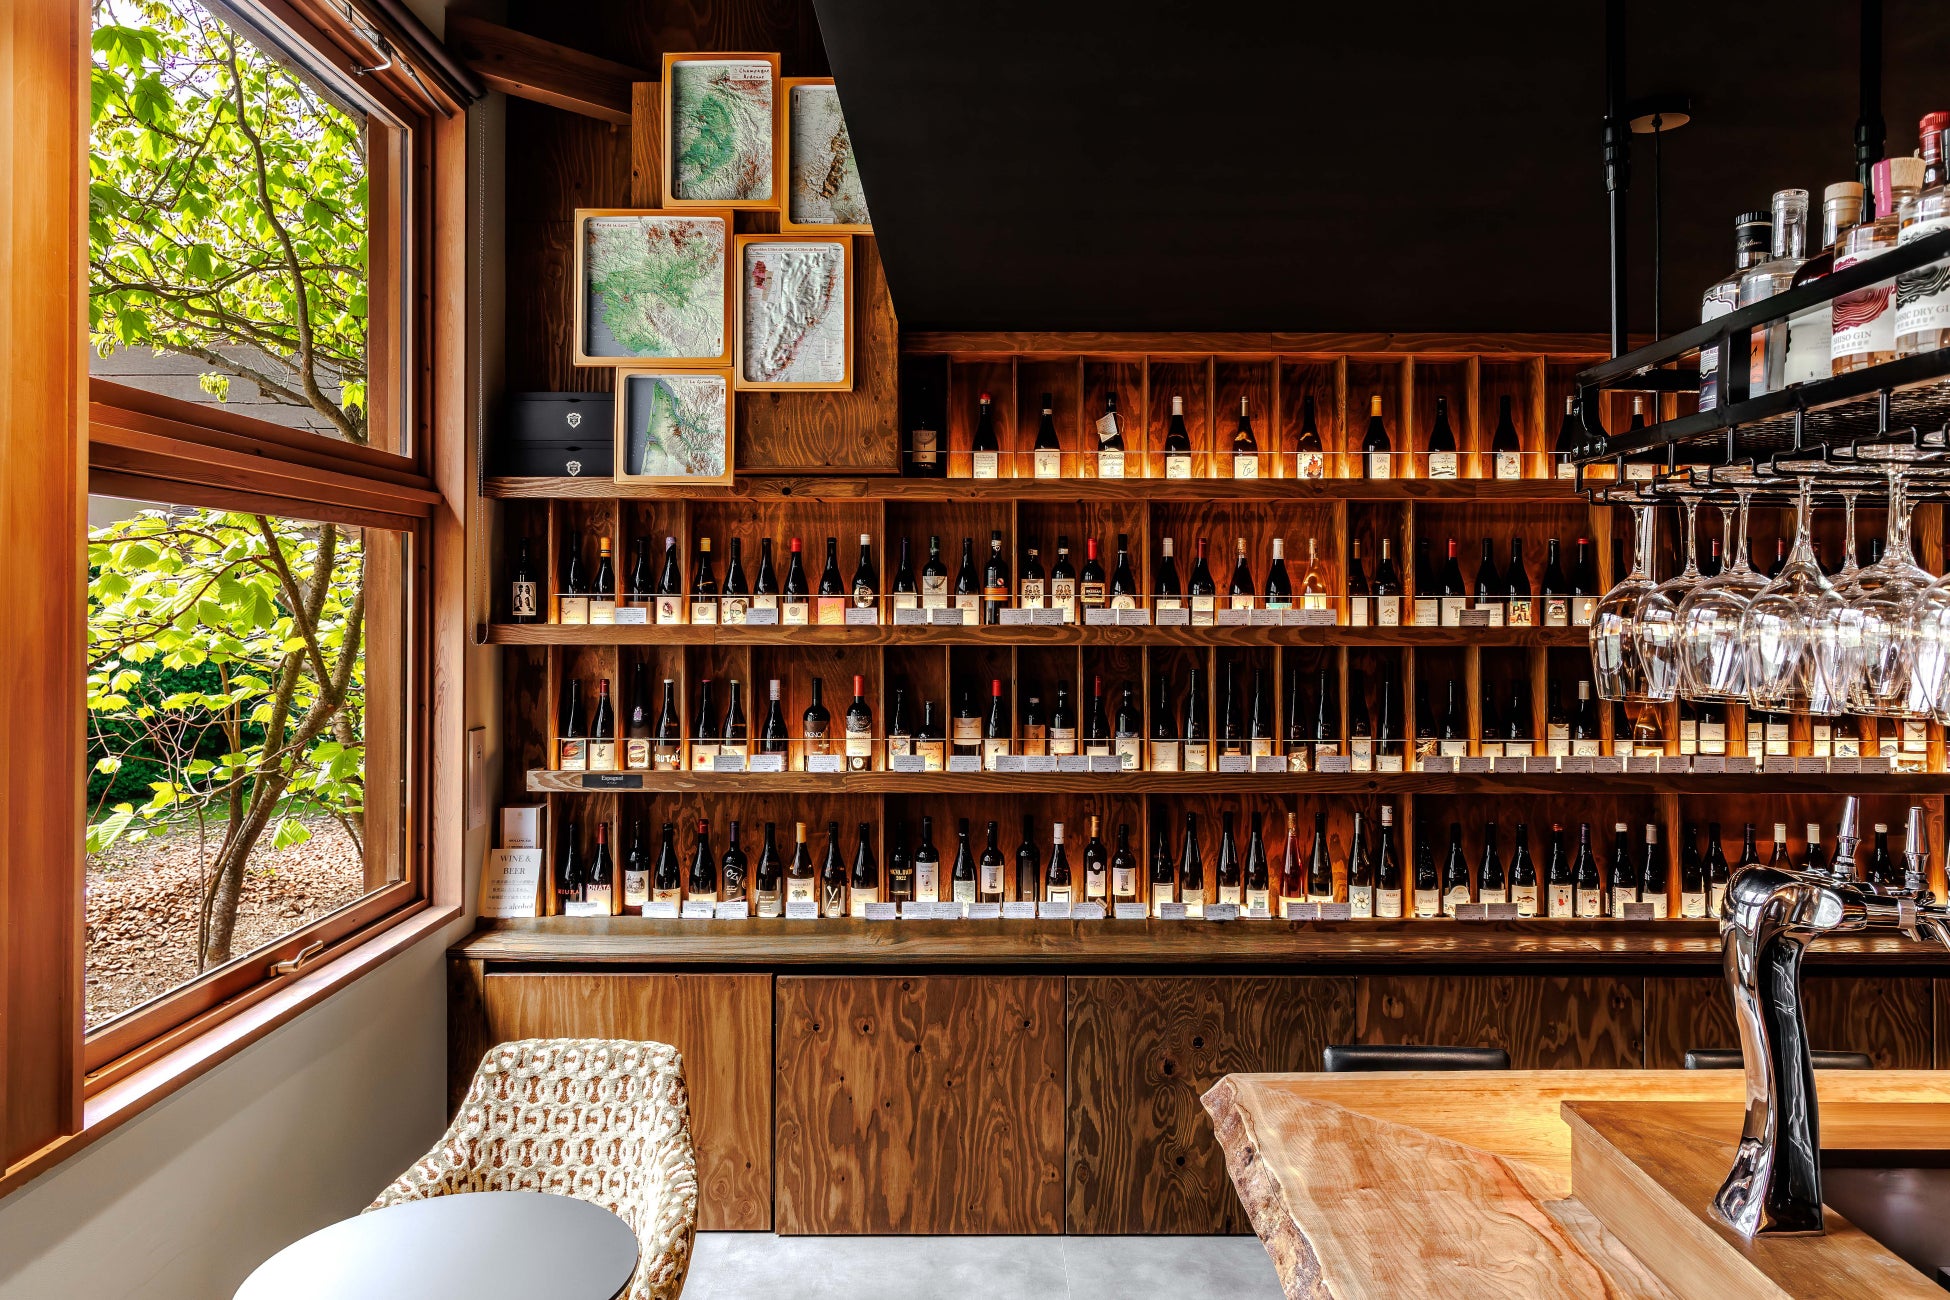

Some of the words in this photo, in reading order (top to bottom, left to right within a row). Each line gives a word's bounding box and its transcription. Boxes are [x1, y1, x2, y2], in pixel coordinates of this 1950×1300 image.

[1913, 306, 1934, 317] DRY
[1936, 304, 1950, 313] GI
[1853, 330, 1872, 341] GIN
[500, 855, 524, 863] WINE
[524, 855, 532, 863] &
[503, 867, 526, 875] BEER
